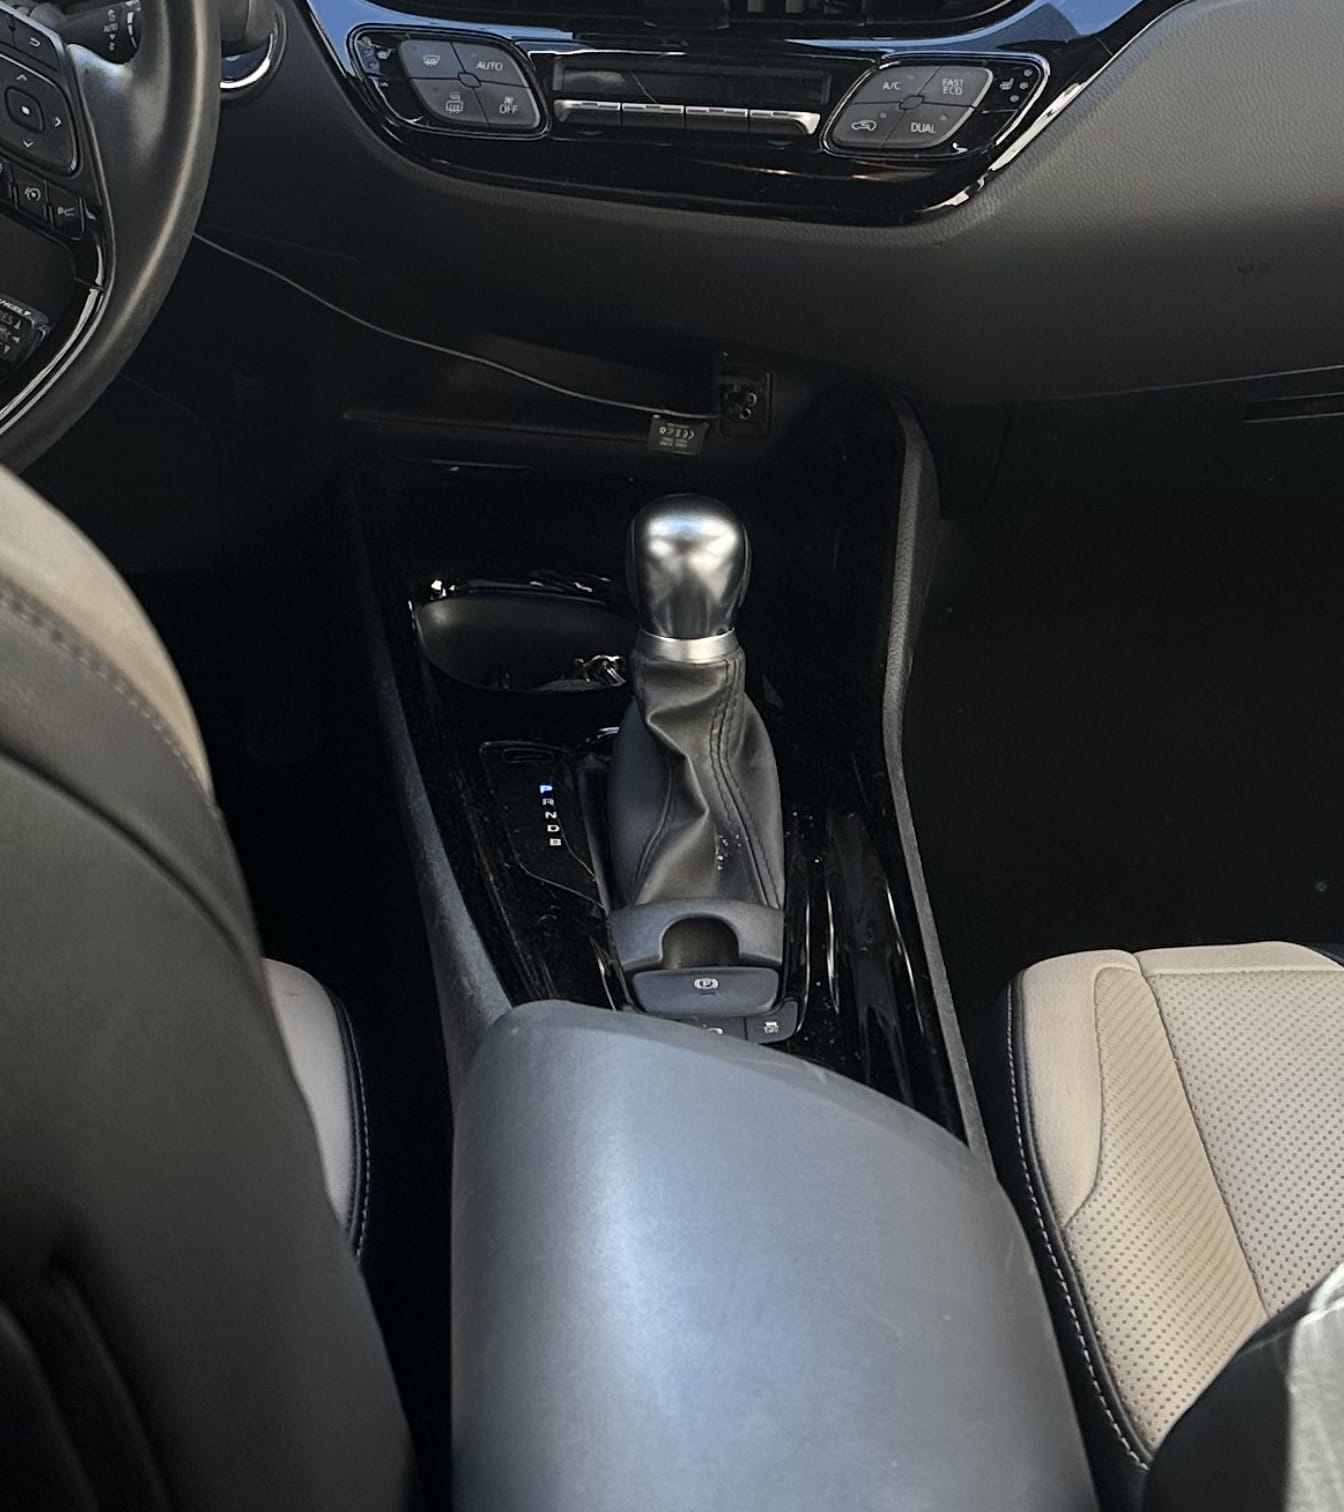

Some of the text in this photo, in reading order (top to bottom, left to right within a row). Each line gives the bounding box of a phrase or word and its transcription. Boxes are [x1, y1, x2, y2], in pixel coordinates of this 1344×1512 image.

[475, 60, 504, 72] AUTO
[882, 81, 901, 91] A/C
[941, 78, 965, 88] FAST
[498, 104, 519, 115] OFF
[910, 121, 936, 134] DUAL
[539, 784, 553, 794] P
[542, 798, 554, 806] R
[545, 811, 557, 819] N
[547, 824, 561, 832] D
